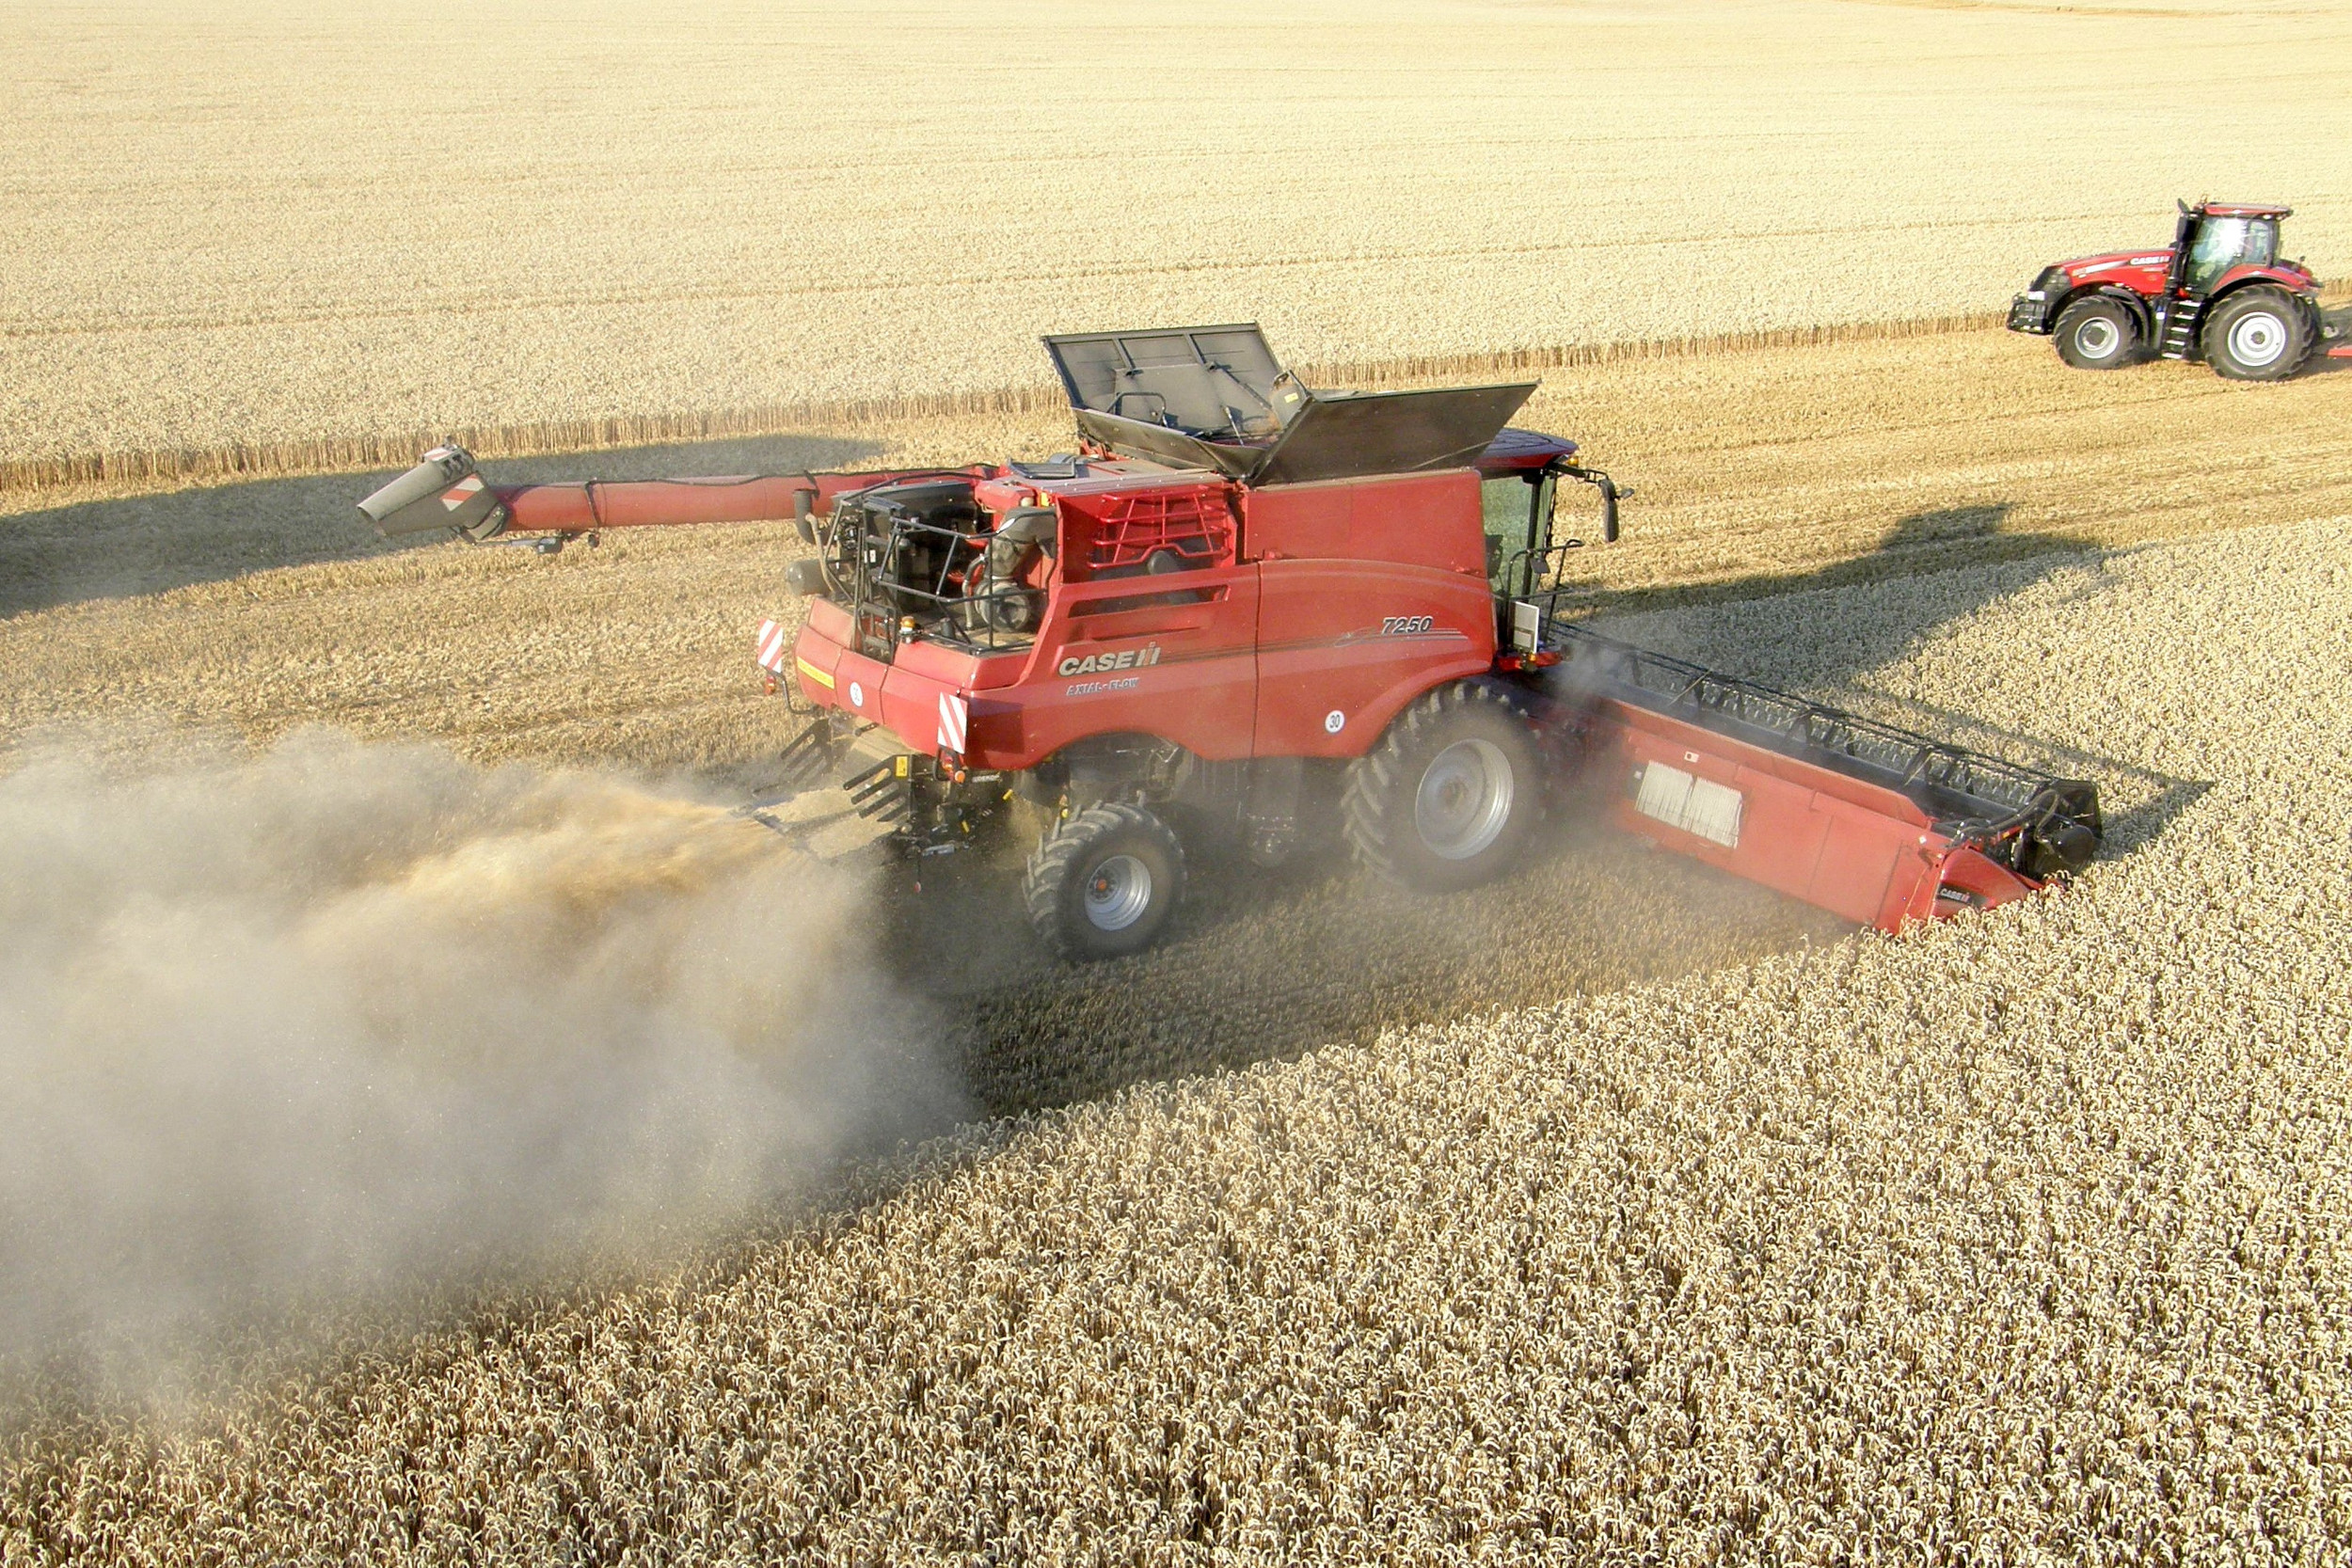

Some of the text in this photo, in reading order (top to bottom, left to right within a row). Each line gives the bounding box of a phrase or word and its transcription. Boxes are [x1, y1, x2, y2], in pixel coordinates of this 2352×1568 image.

[1381, 615, 1434, 635] 7250
[1058, 650, 1135, 676] CASE
[1066, 677, 1139, 696] AXIAL-FLOW
[1329, 714, 1341, 729] 30
[1940, 888, 1962, 900] CASE
